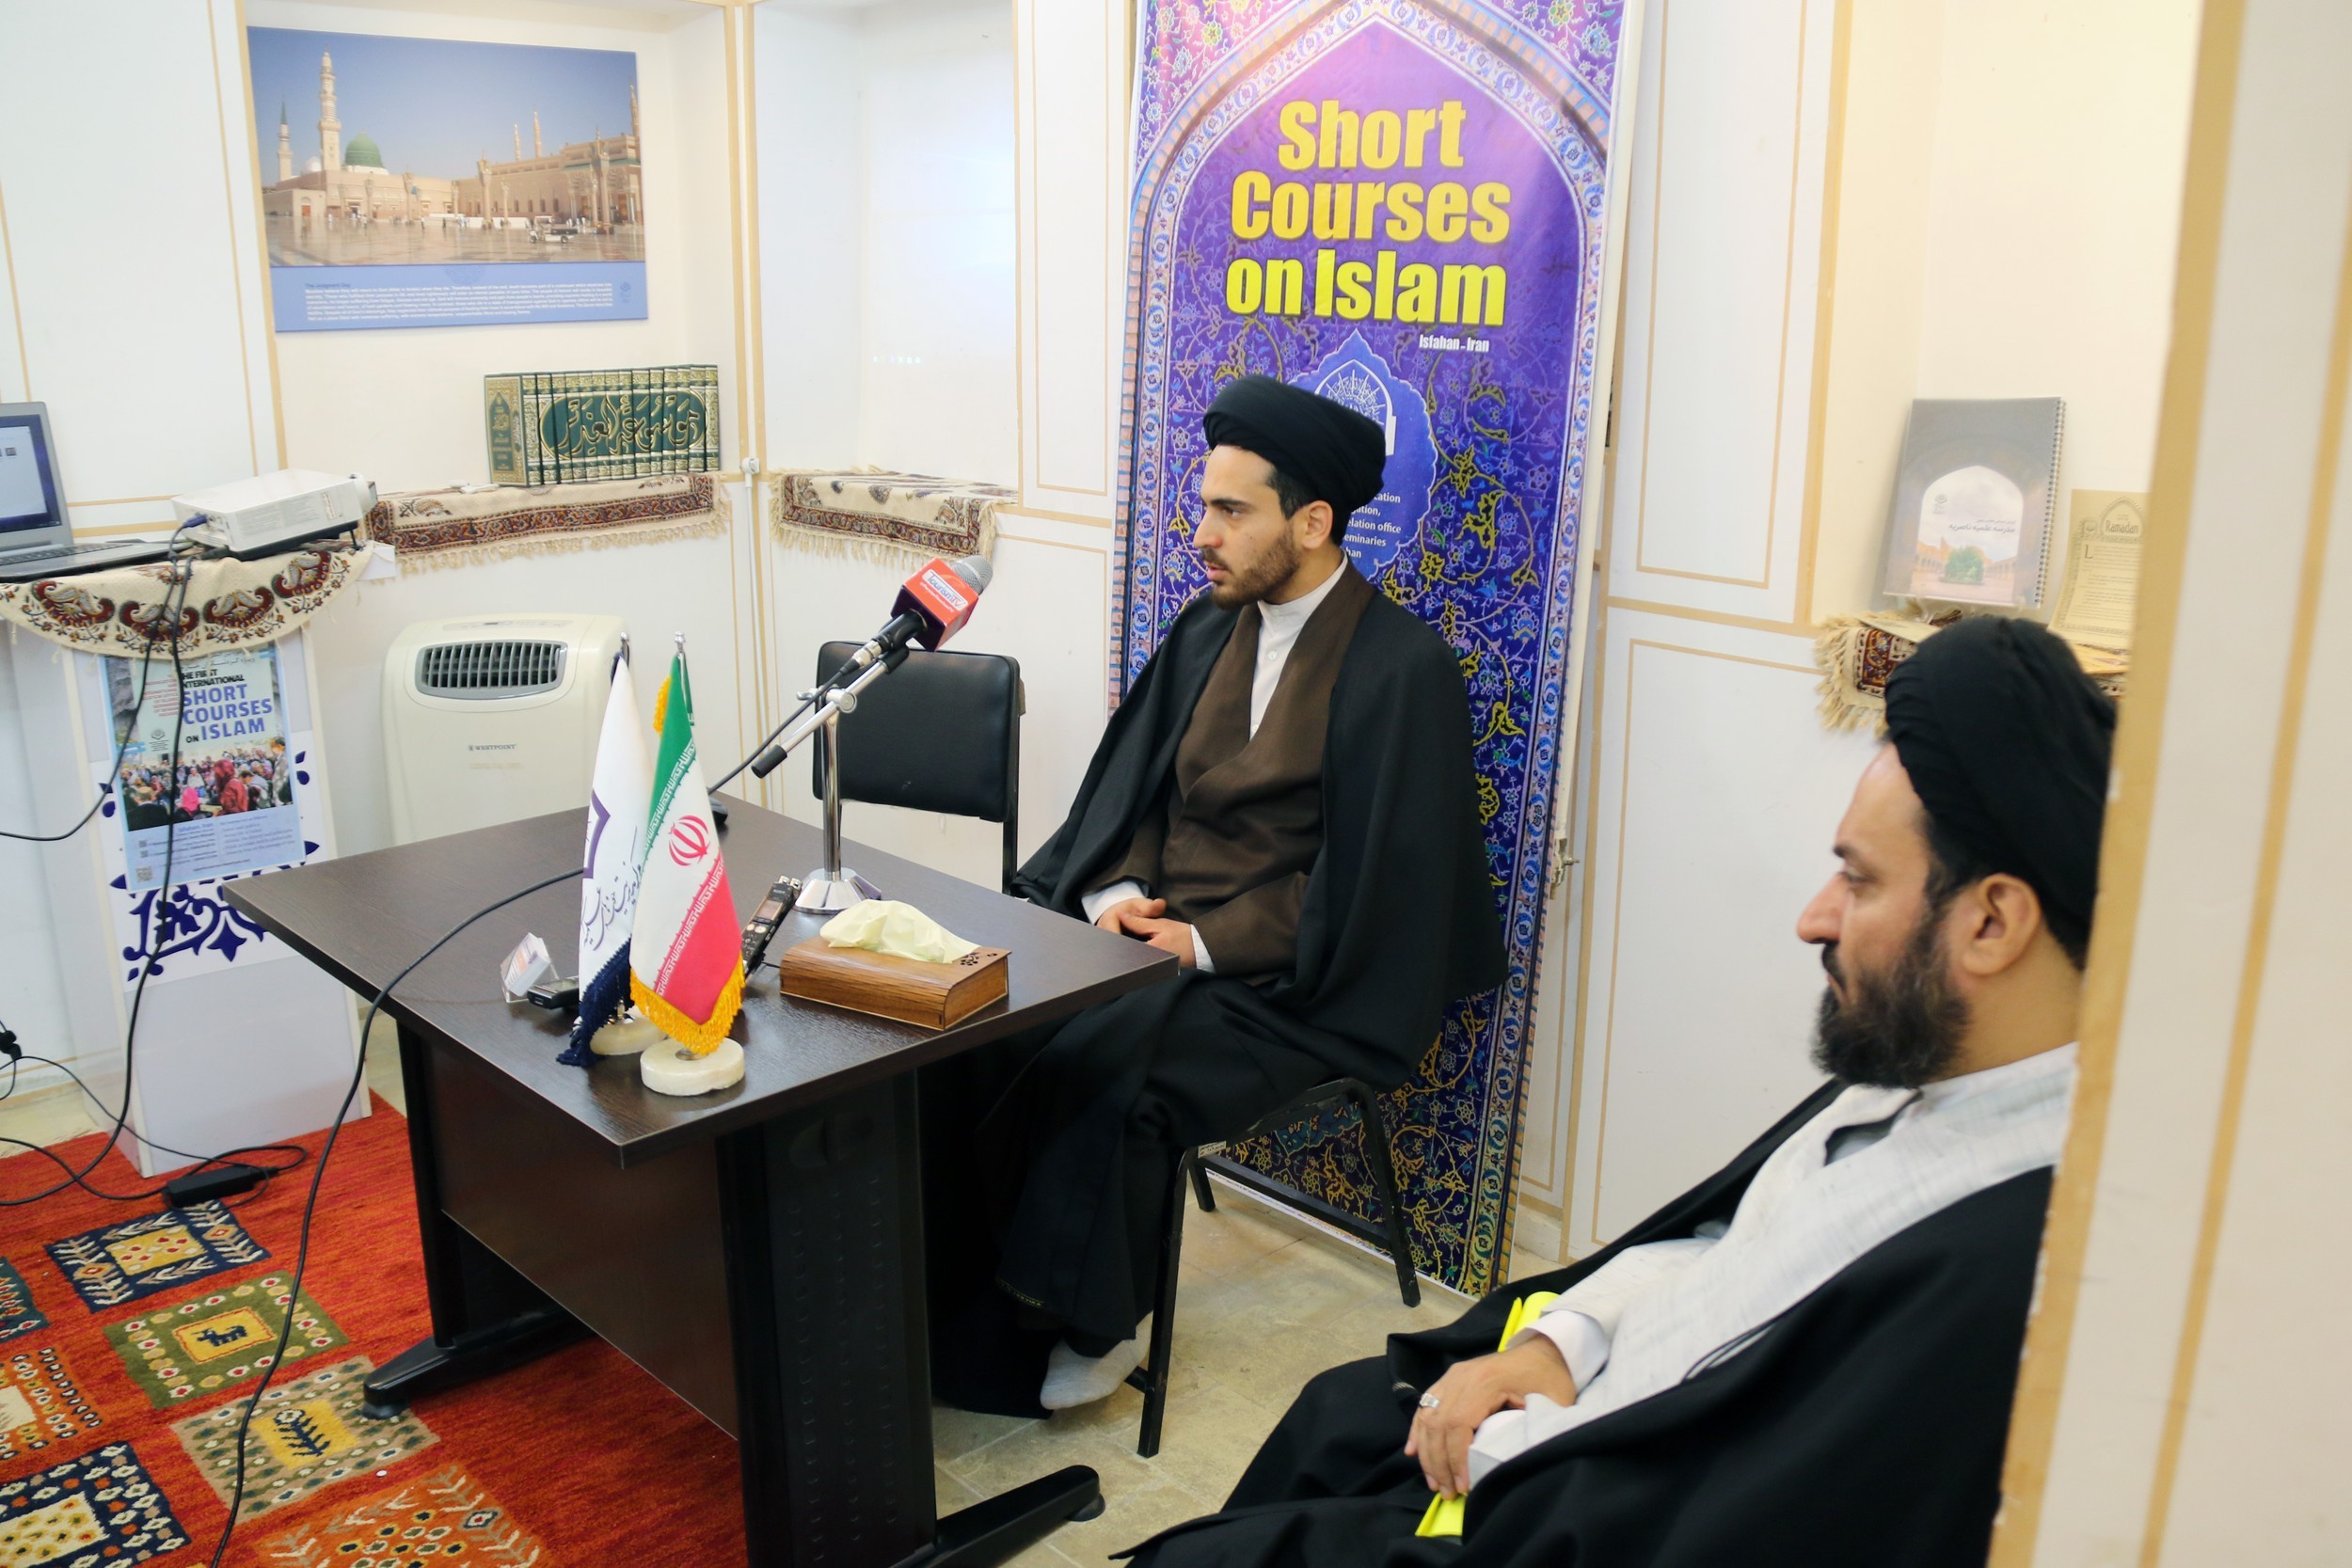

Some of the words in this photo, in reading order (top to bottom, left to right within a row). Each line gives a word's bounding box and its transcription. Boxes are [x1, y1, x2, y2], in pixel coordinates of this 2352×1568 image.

[1278, 100, 1466, 171] Short
[1231, 170, 1511, 244] Courses
[1226, 258, 1304, 315] on
[1314, 248, 1506, 325] Islam
[1419, 333, 1460, 350] Isfahan
[1467, 337, 1489, 353] Iran
[1374, 492, 1401, 503] ation
[1351, 504, 1381, 516] ation,
[1347, 517, 1375, 531] elation
[1377, 522, 1402, 533] office
[2106, 519, 2138, 534] Ramadan
[1343, 533, 1387, 546] eminaries
[1345, 546, 1361, 558] han
[182, 672, 194, 680] HE
[183, 674, 245, 689] NTERNATIONAL
[183, 684, 247, 707] SHORT
[183, 698, 272, 724] COURSES
[201, 718, 265, 740] ISLAM
